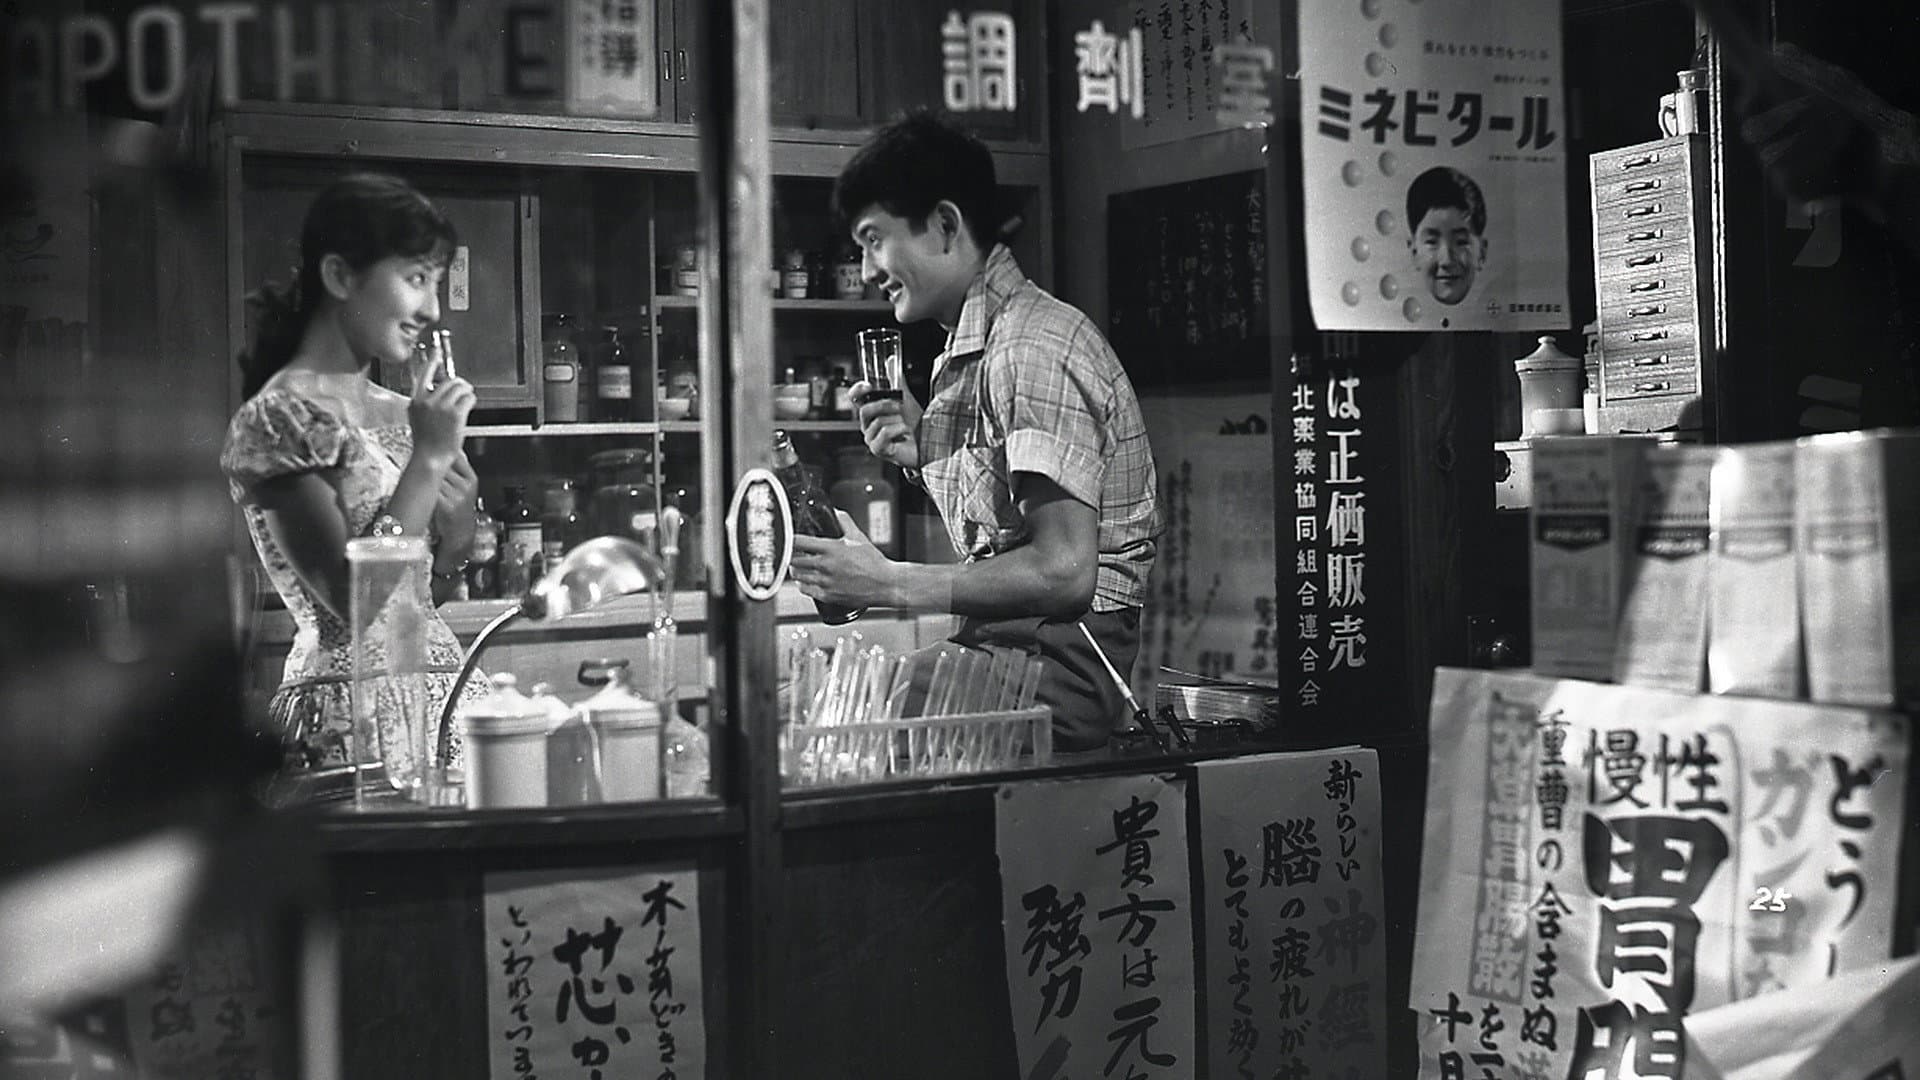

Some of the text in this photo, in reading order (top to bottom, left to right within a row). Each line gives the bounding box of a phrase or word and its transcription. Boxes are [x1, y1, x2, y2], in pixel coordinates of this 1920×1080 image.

[1317, 85, 1559, 150] ミネビタール
[1289, 353, 1321, 706] 北薬業協同組合連合会
[1583, 727, 1730, 814] 慢性
